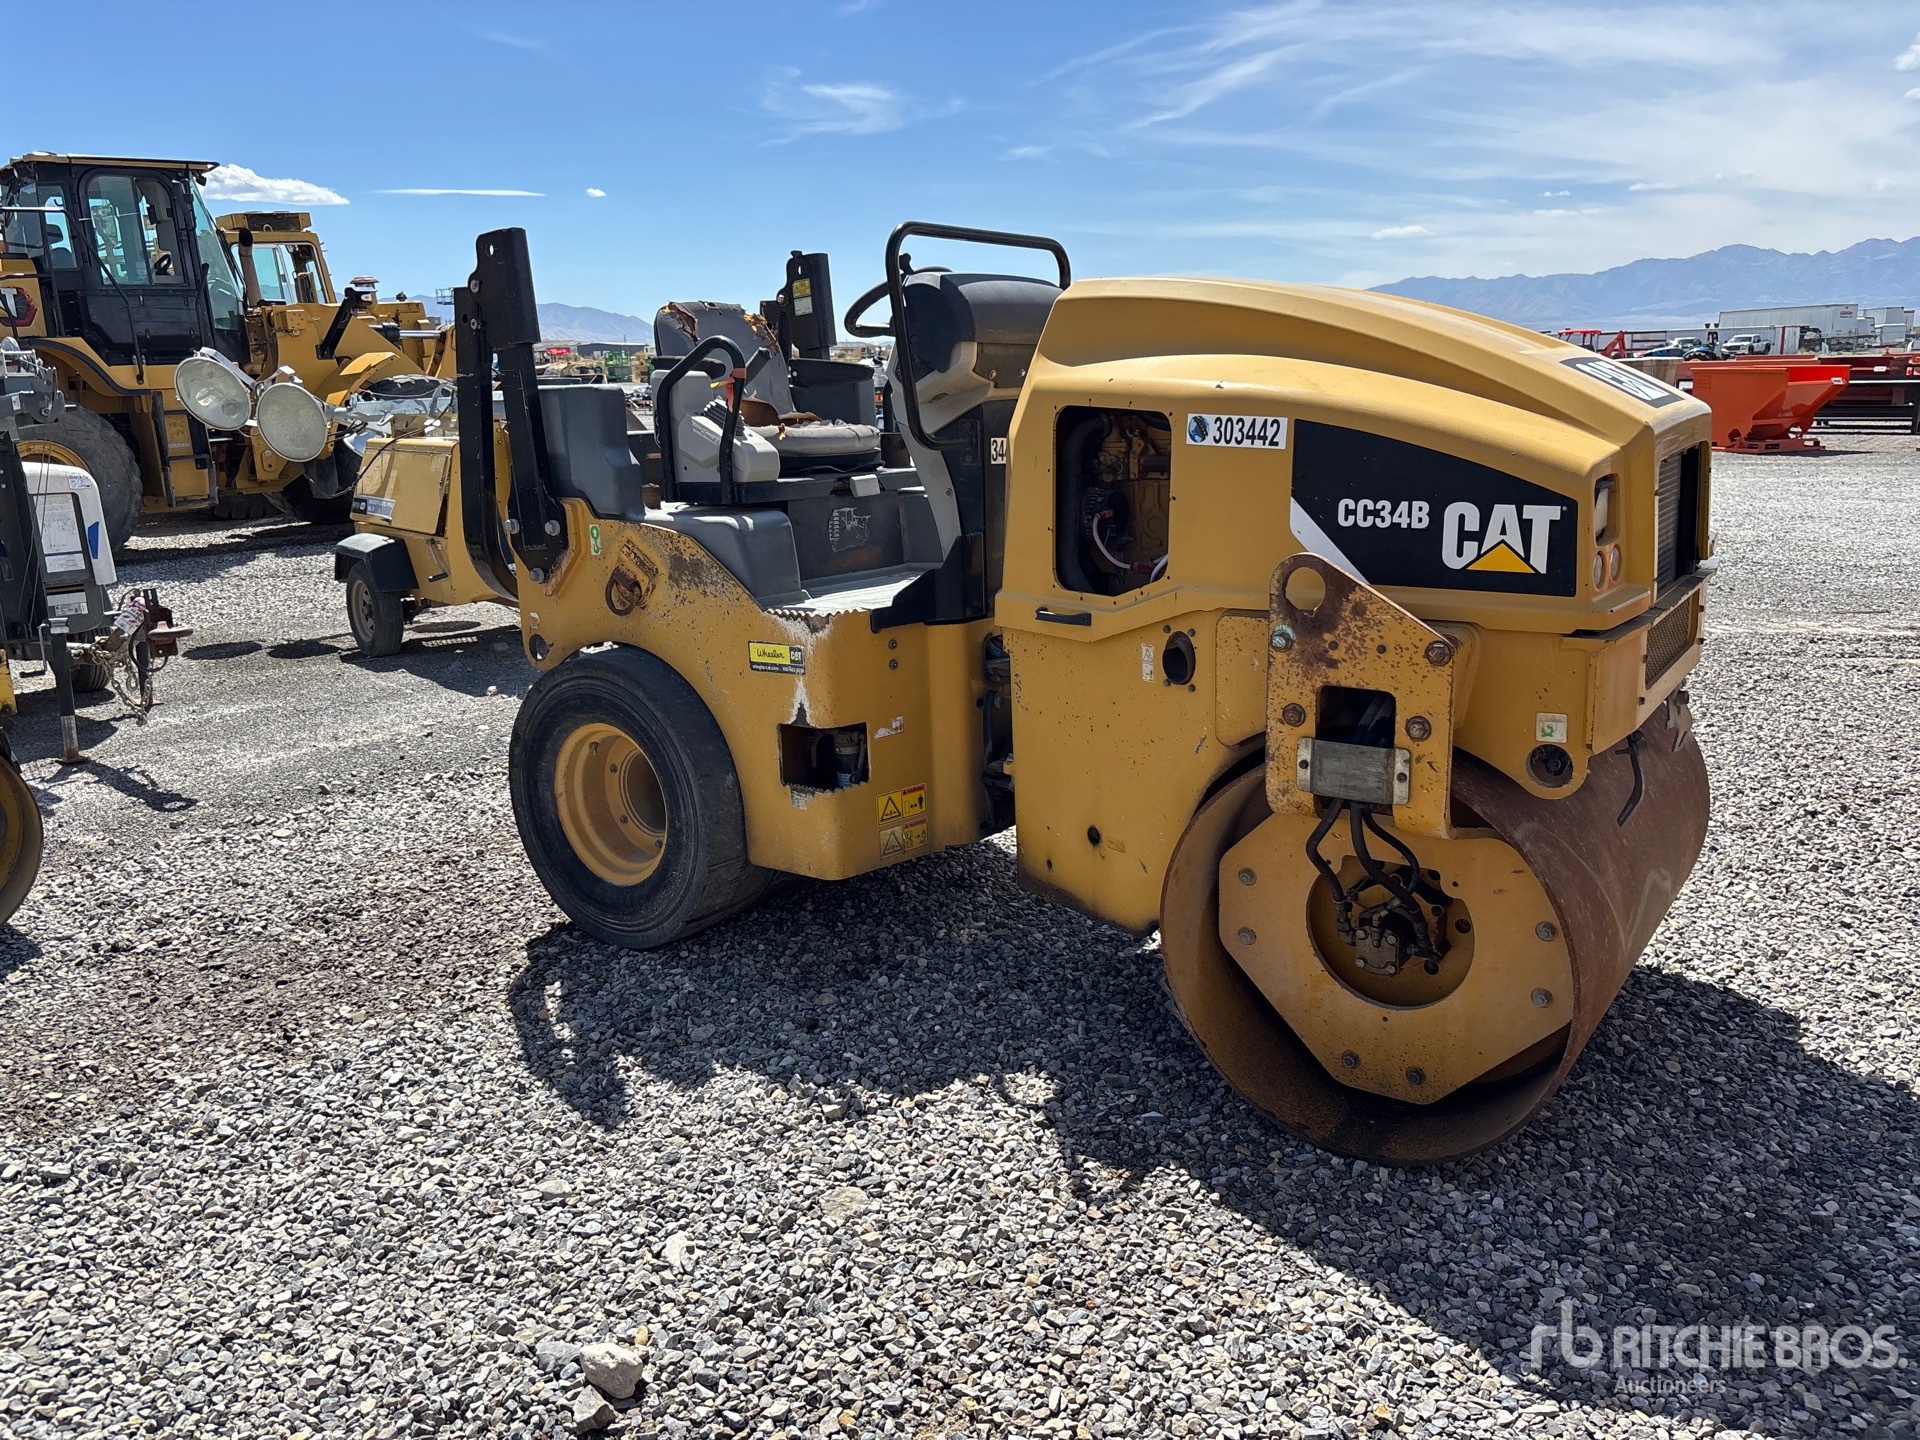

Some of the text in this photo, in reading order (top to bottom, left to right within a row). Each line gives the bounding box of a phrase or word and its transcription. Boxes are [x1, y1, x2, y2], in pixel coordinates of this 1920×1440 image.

[1213, 416, 1281, 447] 303442
[991, 439, 1007, 462] 34
[1337, 498, 1562, 575] CC34B CAT
[756, 648, 802, 661] Wheeler CAT
